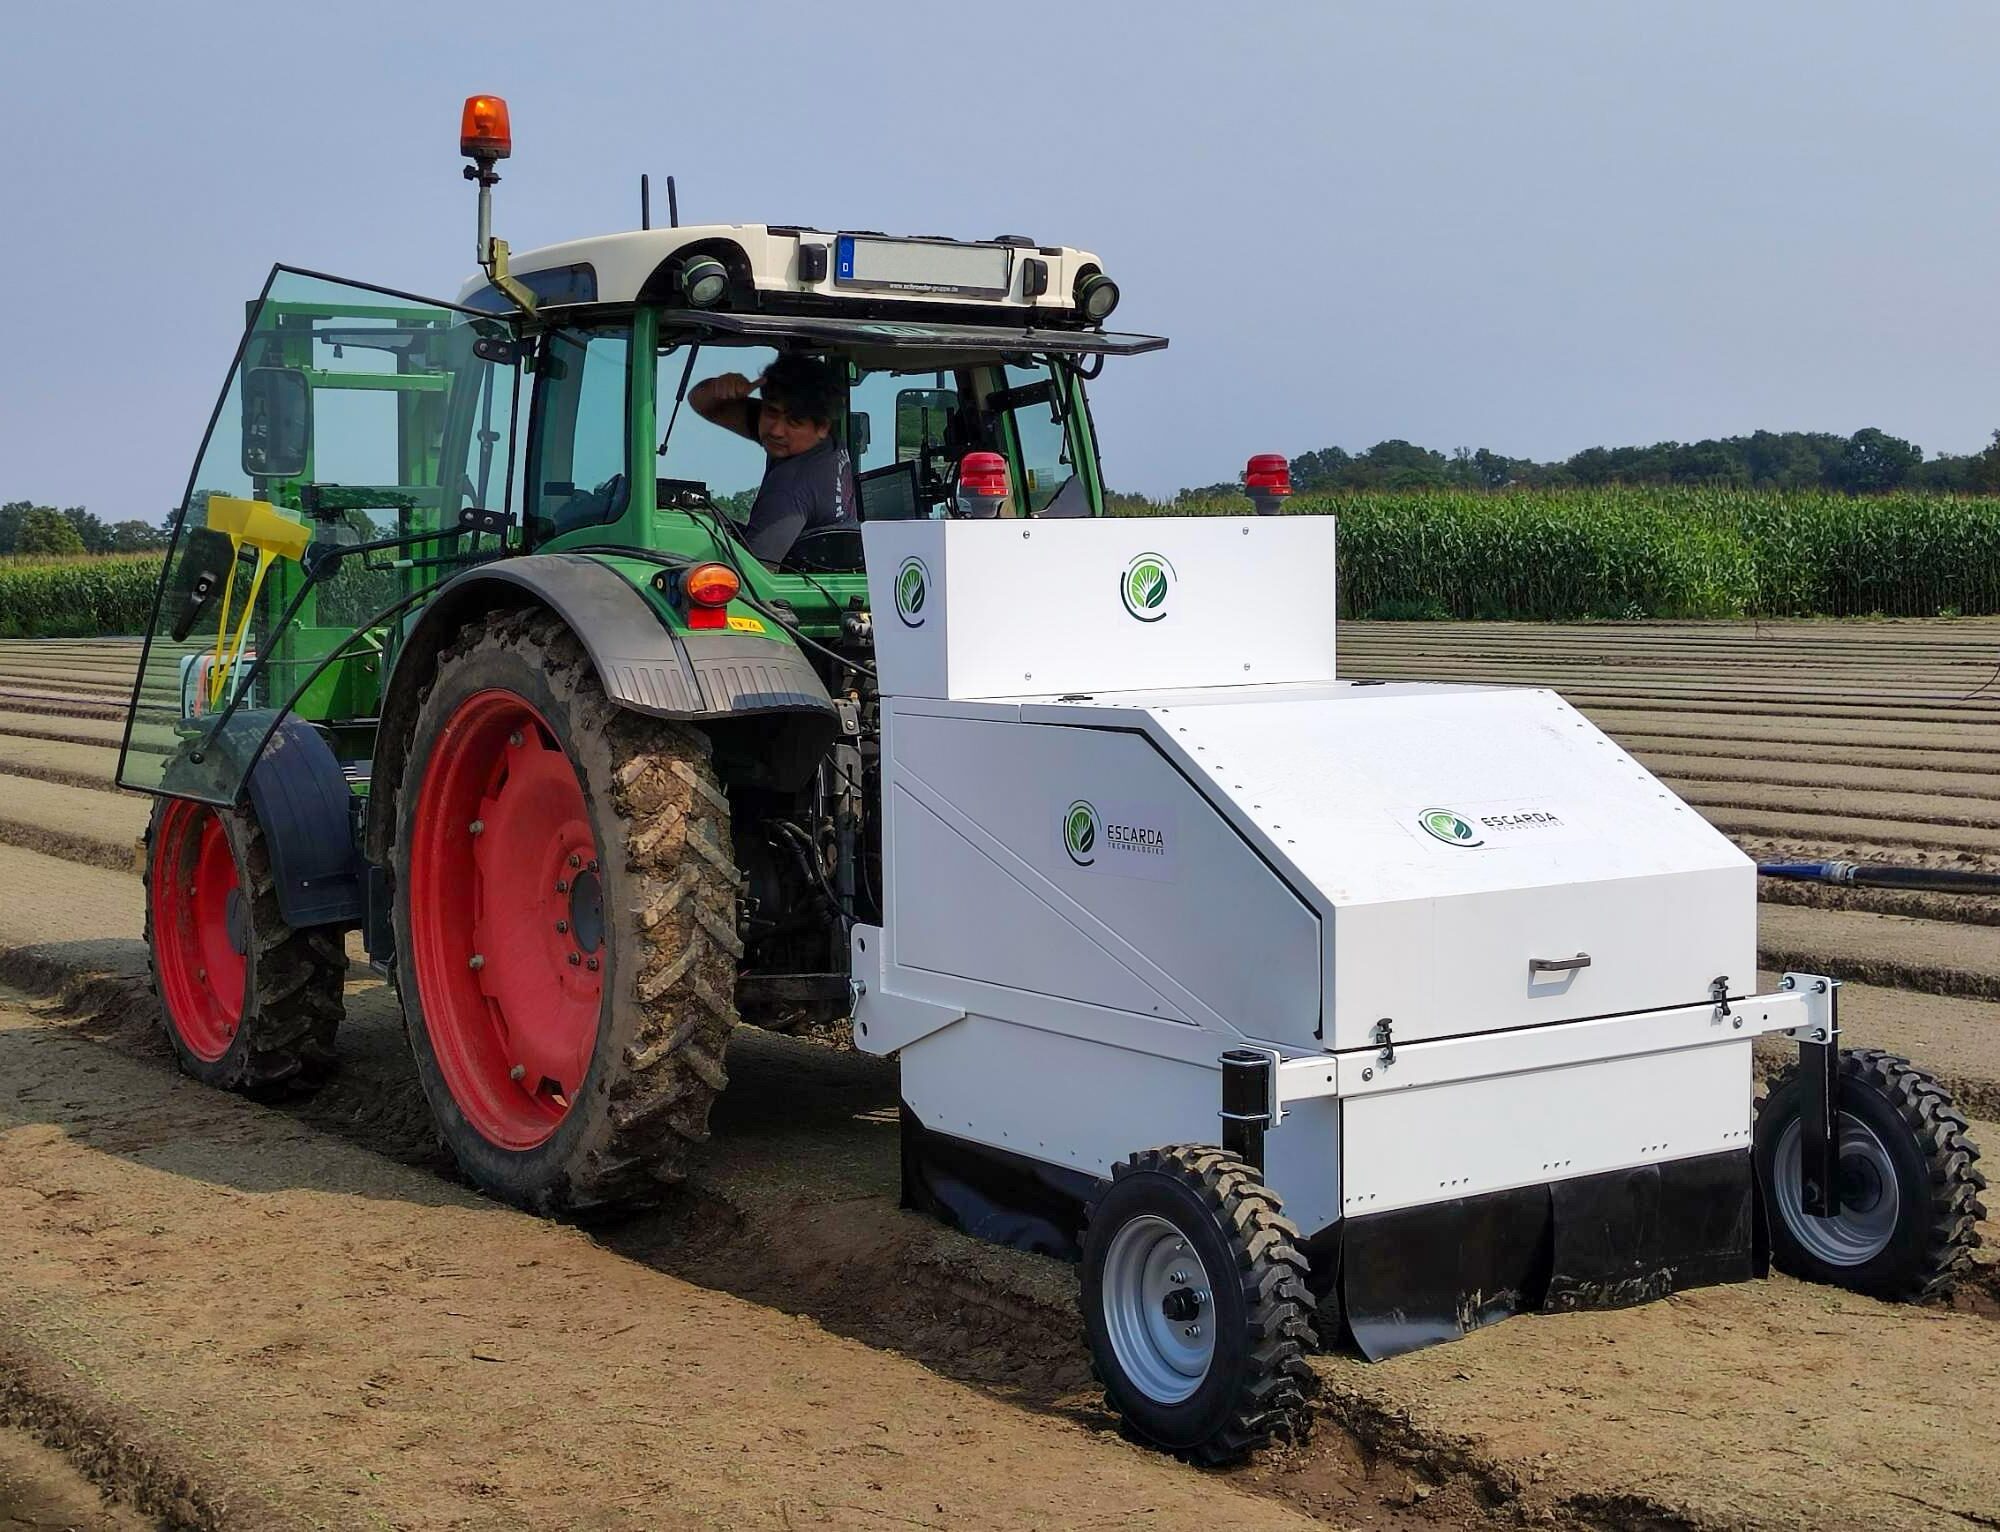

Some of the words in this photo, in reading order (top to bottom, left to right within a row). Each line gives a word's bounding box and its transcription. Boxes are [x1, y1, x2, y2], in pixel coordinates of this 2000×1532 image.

[842, 262, 849, 272] D
[1481, 812, 1559, 827] ESCARDA
[1107, 824, 1164, 846] ESCARDA
[1107, 841, 1165, 856] TECHNOLOGIES
